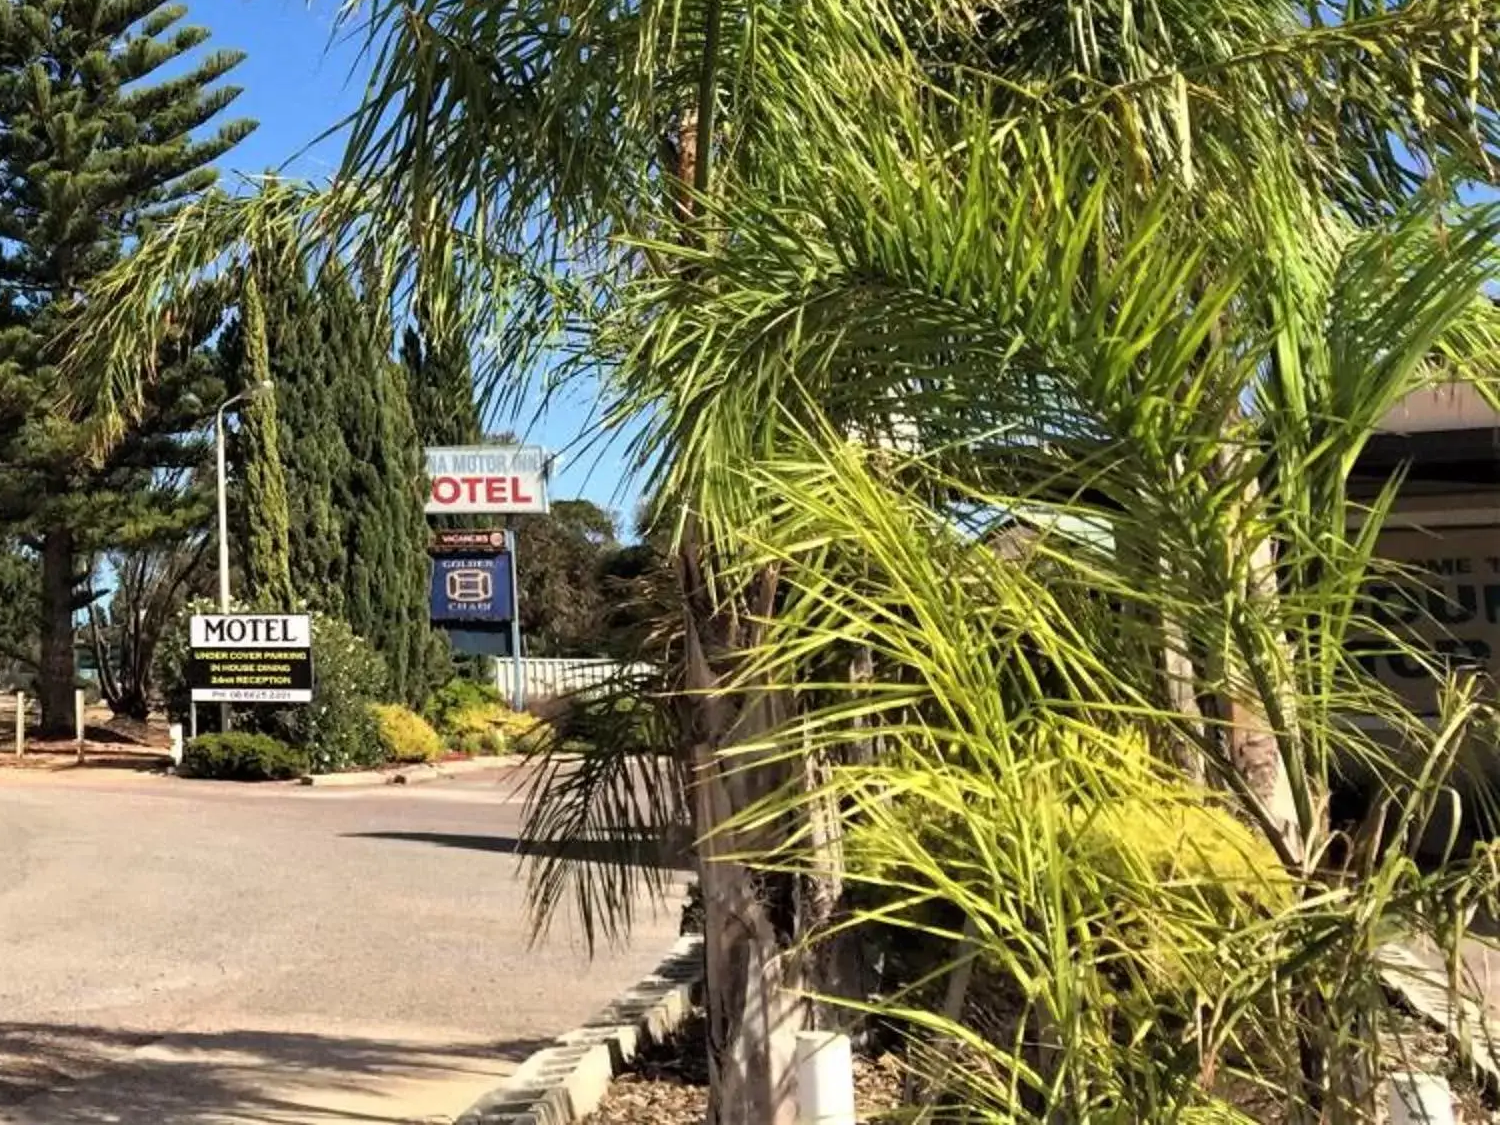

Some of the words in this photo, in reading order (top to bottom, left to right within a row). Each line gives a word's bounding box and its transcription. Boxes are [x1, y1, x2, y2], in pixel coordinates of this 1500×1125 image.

[452, 455, 506, 473] MOTOR
[431, 476, 532, 504] OTEL
[204, 618, 298, 642] MOTEL
[194, 651, 228, 660] UNDER
[230, 651, 262, 660] COVER
[264, 651, 307, 660] PARKING
[210, 664, 220, 672] IN
[222, 664, 255, 672] HOUSE
[257, 664, 291, 672] DINING
[236, 676, 291, 684] RECEPTION
